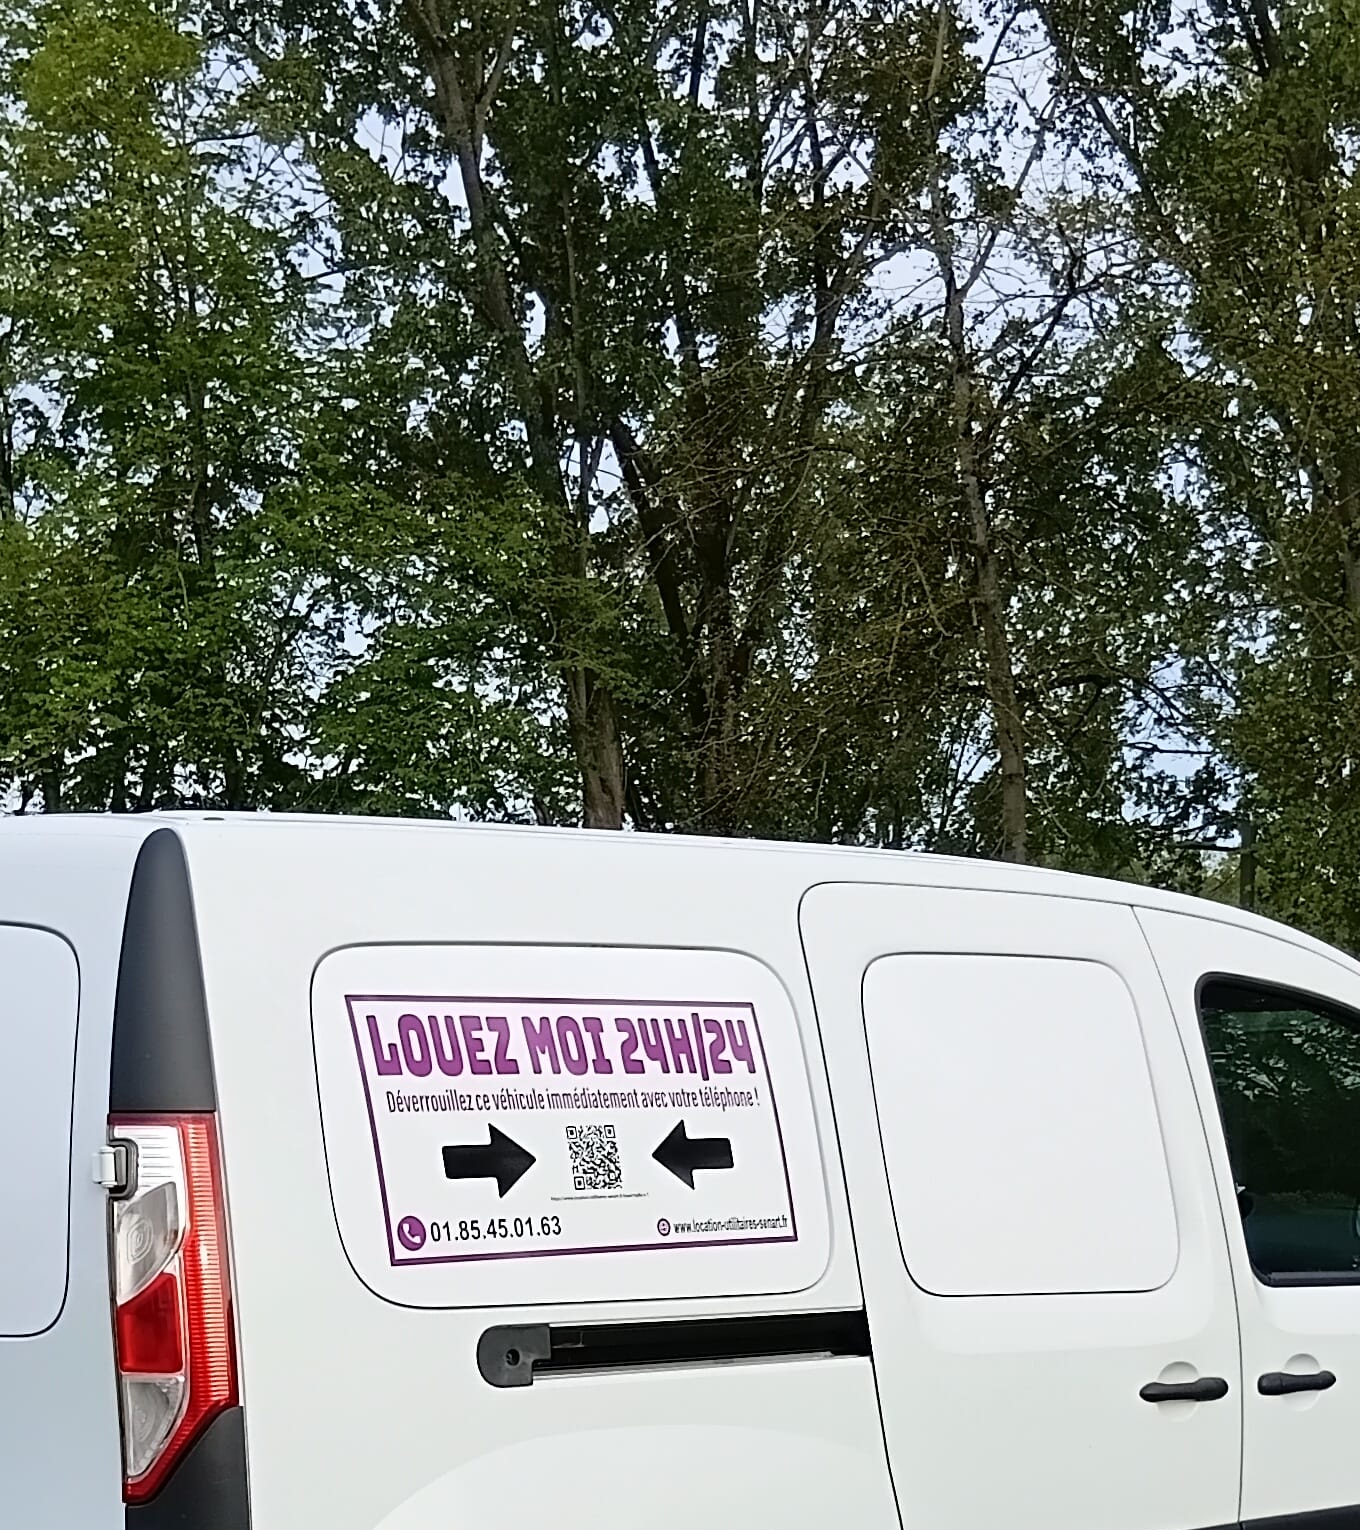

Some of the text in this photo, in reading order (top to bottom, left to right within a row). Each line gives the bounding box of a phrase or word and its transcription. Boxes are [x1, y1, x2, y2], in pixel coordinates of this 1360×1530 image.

[366, 1013, 756, 1081] LOUEZ MOI 24H/24
[386, 1089, 473, 1113] Déverrouillez
[475, 1093, 491, 1110] ce
[492, 1088, 545, 1111] véhicule
[546, 1087, 640, 1110] immédiatement
[641, 1092, 667, 1108] avec
[668, 1088, 698, 1108] votre
[699, 1087, 752, 1112] téléphone
[430, 1215, 562, 1242] 01.85.45.01.63
